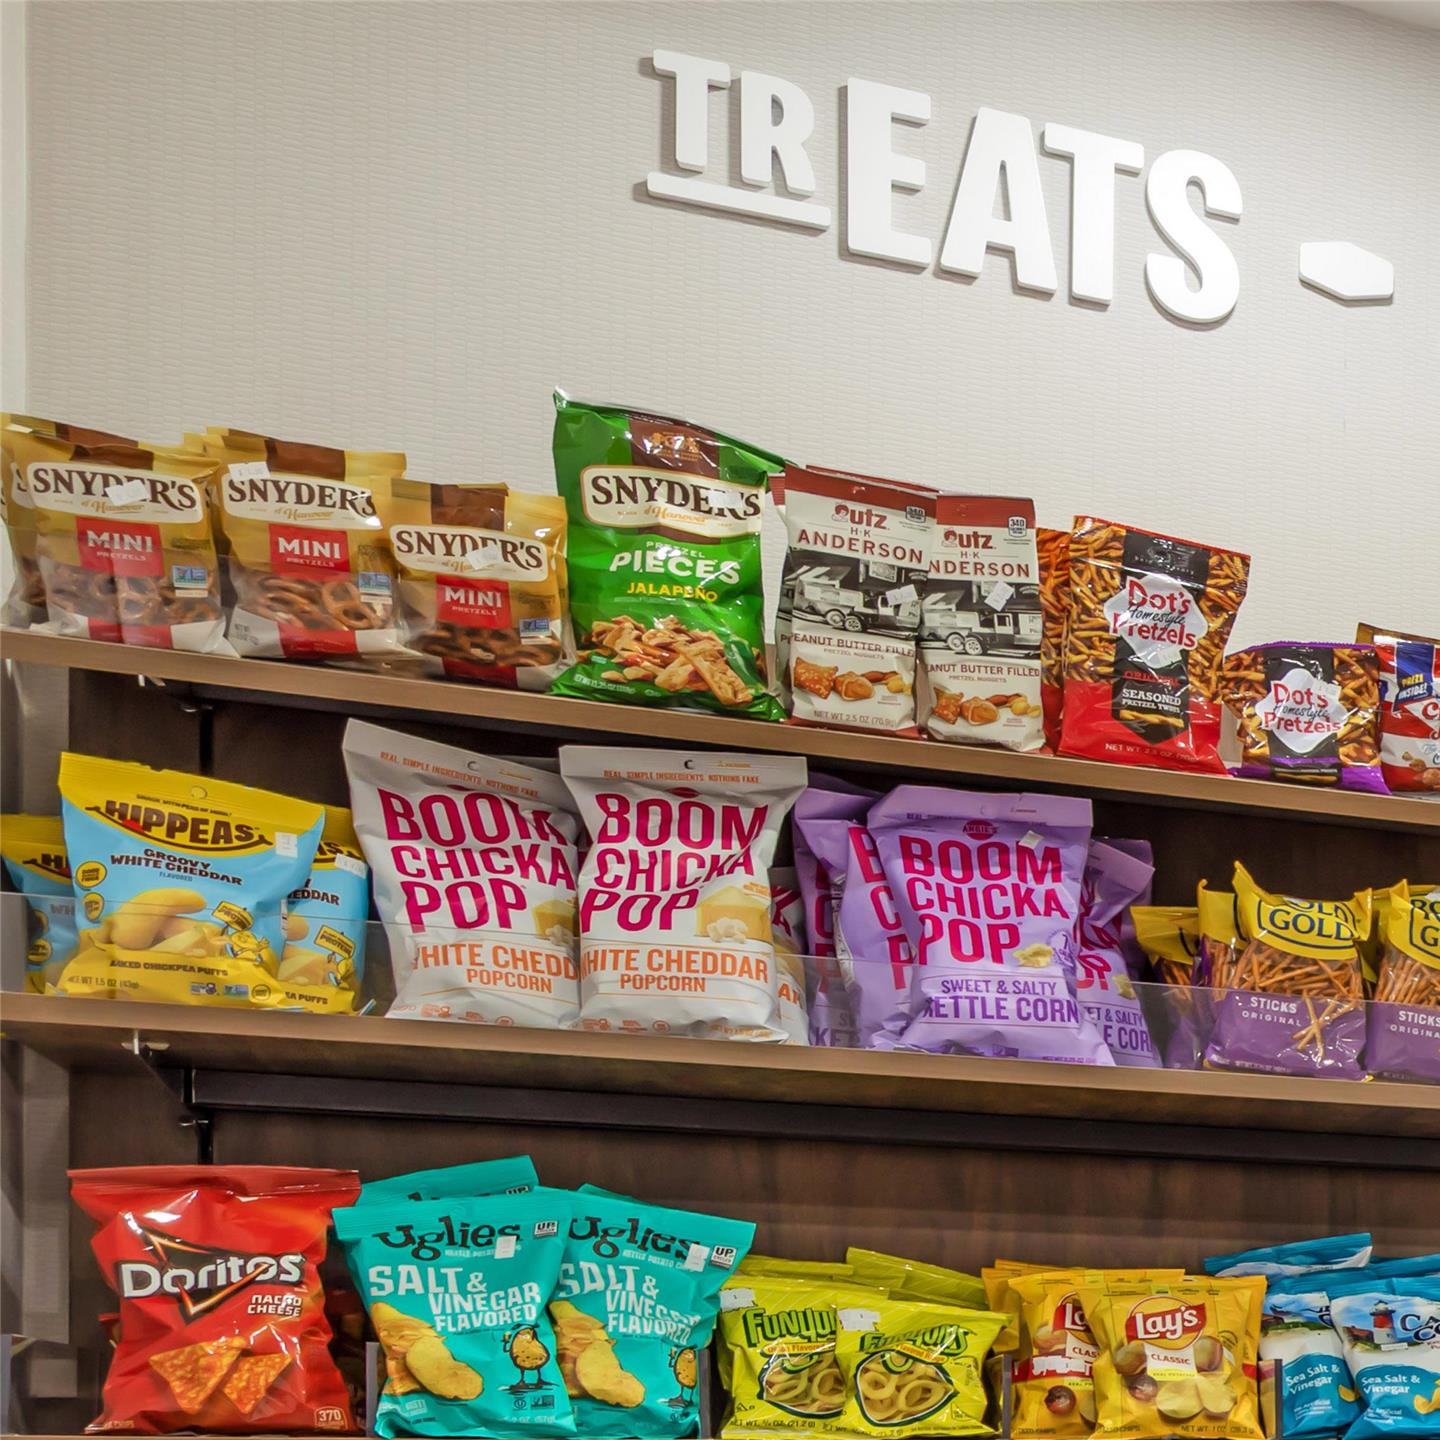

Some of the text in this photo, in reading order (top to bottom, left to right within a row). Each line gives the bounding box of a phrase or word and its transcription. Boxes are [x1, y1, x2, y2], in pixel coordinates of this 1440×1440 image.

[647, 48, 1243, 326] TREATS
[87, 530, 152, 552] MINI
[278, 537, 340, 559] MINI
[798, 529, 922, 564] ANDERSON
[609, 550, 741, 584] PIECES
[445, 588, 501, 608] MINI
[1128, 579, 1191, 615] Dot's
[1112, 612, 1196, 648] Pretzels
[1122, 687, 1182, 706] SEASONED
[1264, 712, 1341, 734] Pretzels
[105, 800, 254, 845] HIPPEAS
[377, 788, 564, 848] BOOM
[594, 793, 768, 850] BOOM
[391, 845, 577, 891] CHICKA
[594, 848, 754, 892] CHICKA
[898, 835, 1063, 886] BOOM
[400, 879, 527, 934] POP
[580, 887, 701, 934] POP
[907, 877, 1071, 919] CHICKA
[918, 913, 1020, 965] POP
[467, 970, 552, 994] POPCORN
[619, 973, 706, 993] POPCORN
[924, 997, 1079, 1023] KETTLE CORN
[1250, 996, 1298, 1014] STICKS
[120, 1254, 304, 1298] Doritos
[428, 1282, 541, 1315] VINEGAR
[434, 1303, 537, 1333] FLAVORED
[607, 1311, 691, 1344] FLAVORED
[1136, 1306, 1198, 1340] Lay's
[318, 1409, 340, 1421] 370
